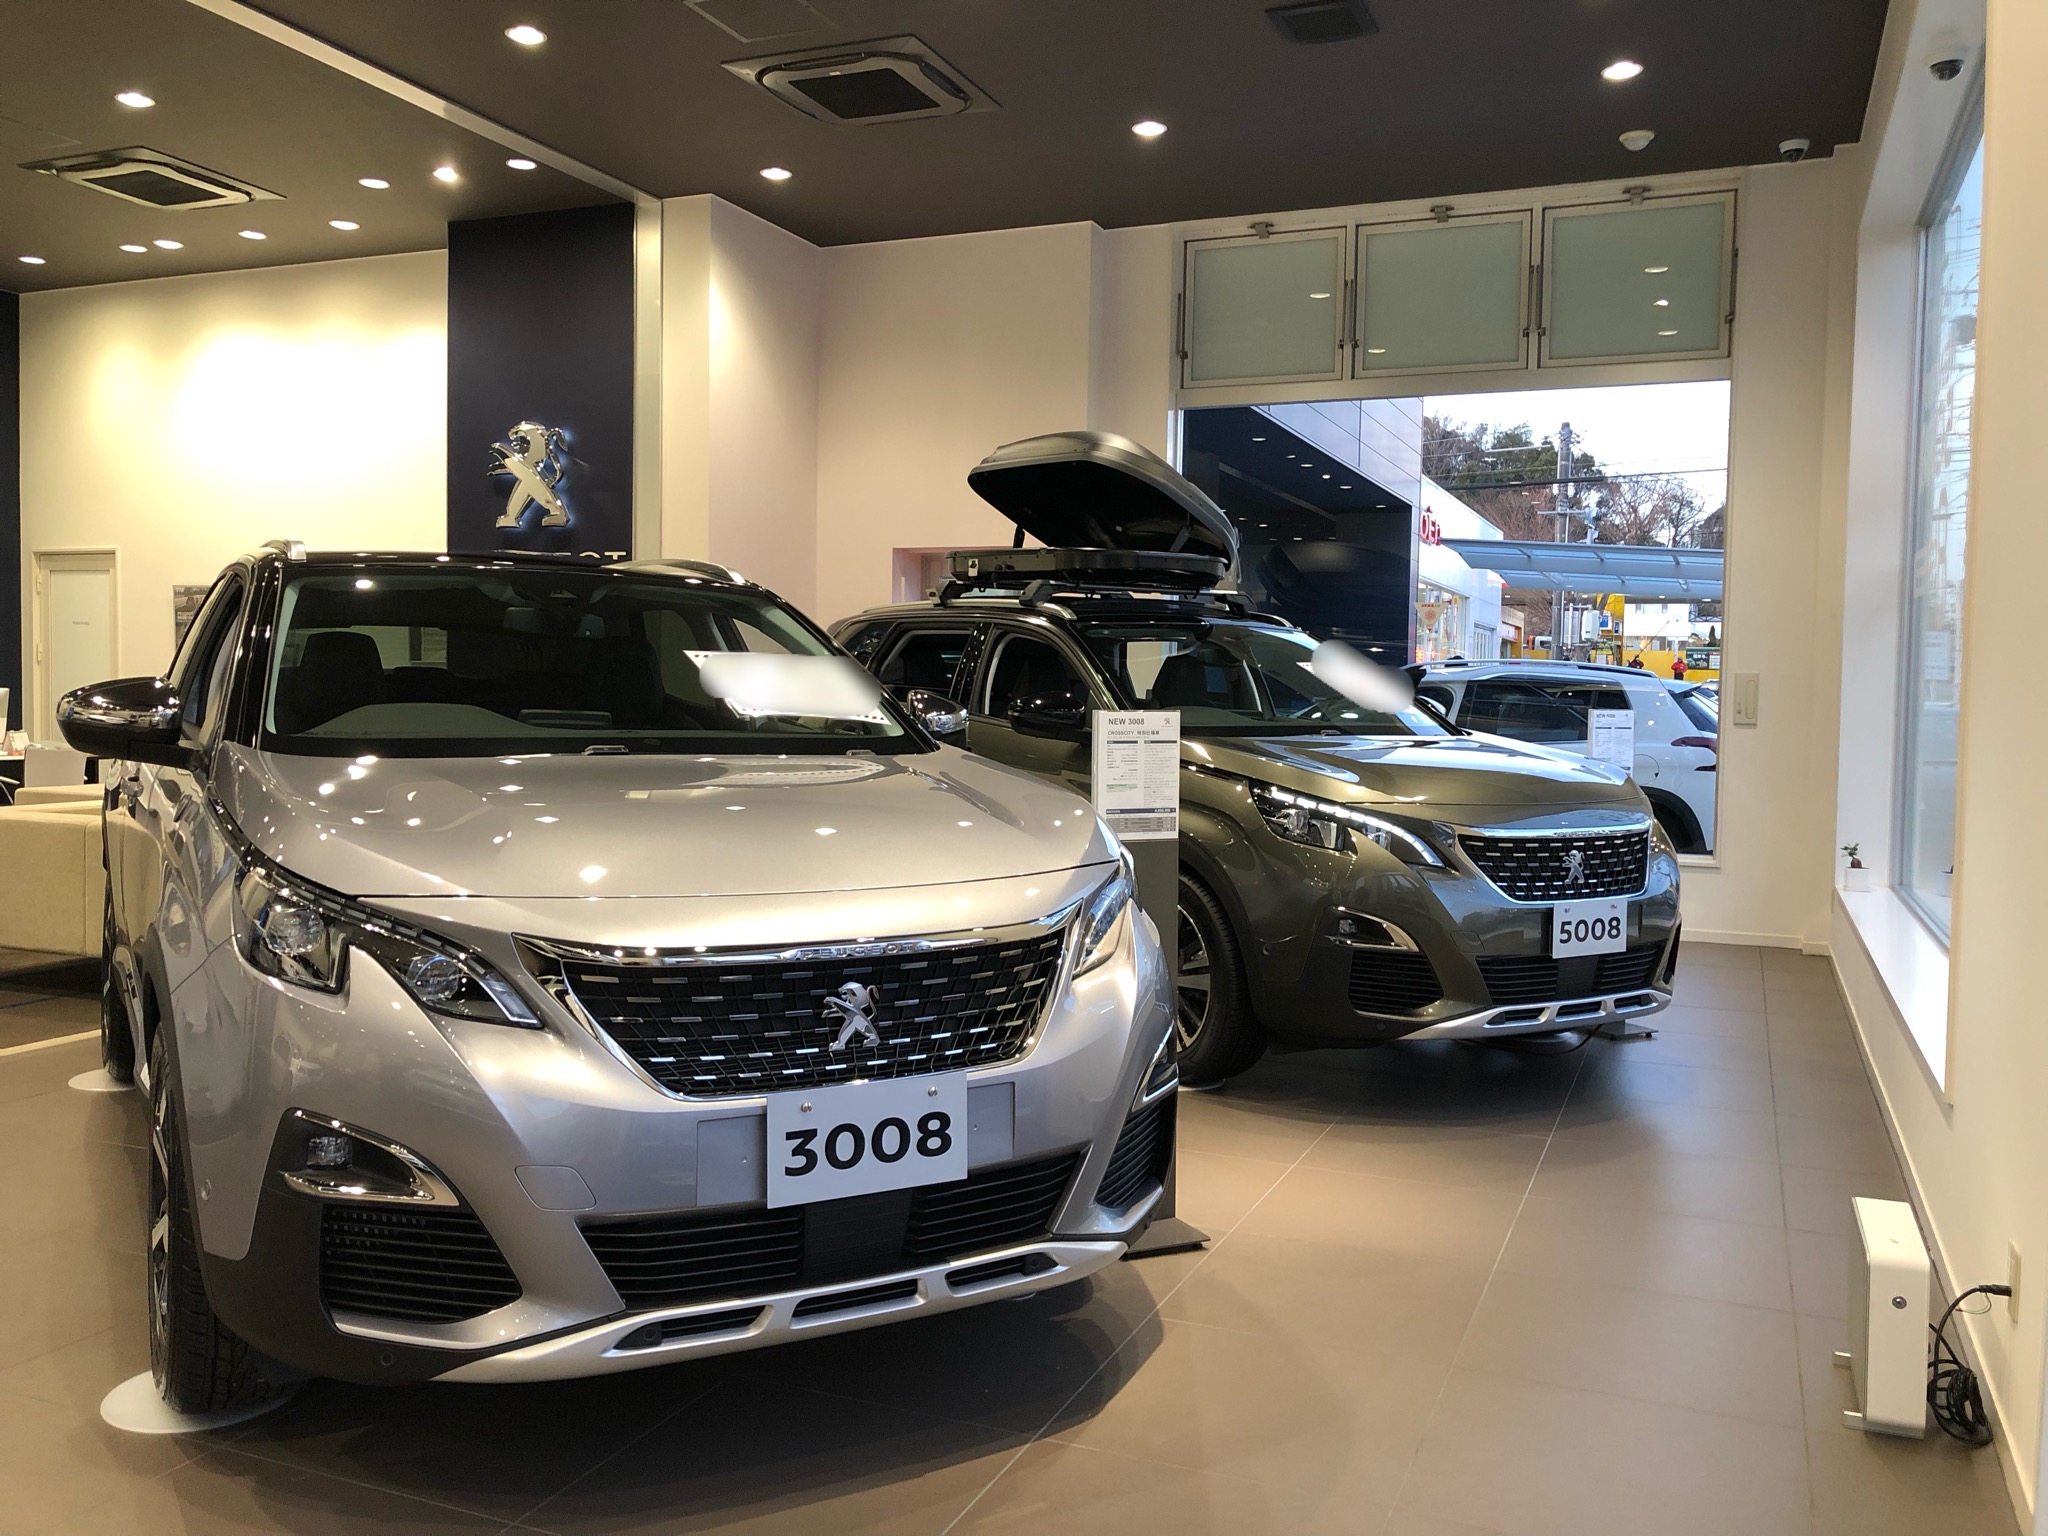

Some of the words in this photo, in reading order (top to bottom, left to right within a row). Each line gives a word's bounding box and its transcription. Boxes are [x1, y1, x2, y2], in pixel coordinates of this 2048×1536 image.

[1108, 717, 1126, 725] NEW
[1128, 717, 1145, 725] 3008
[1559, 916, 1621, 944] 5008
[801, 942, 915, 961] PEUGEOT
[784, 1111, 952, 1177] 3008
